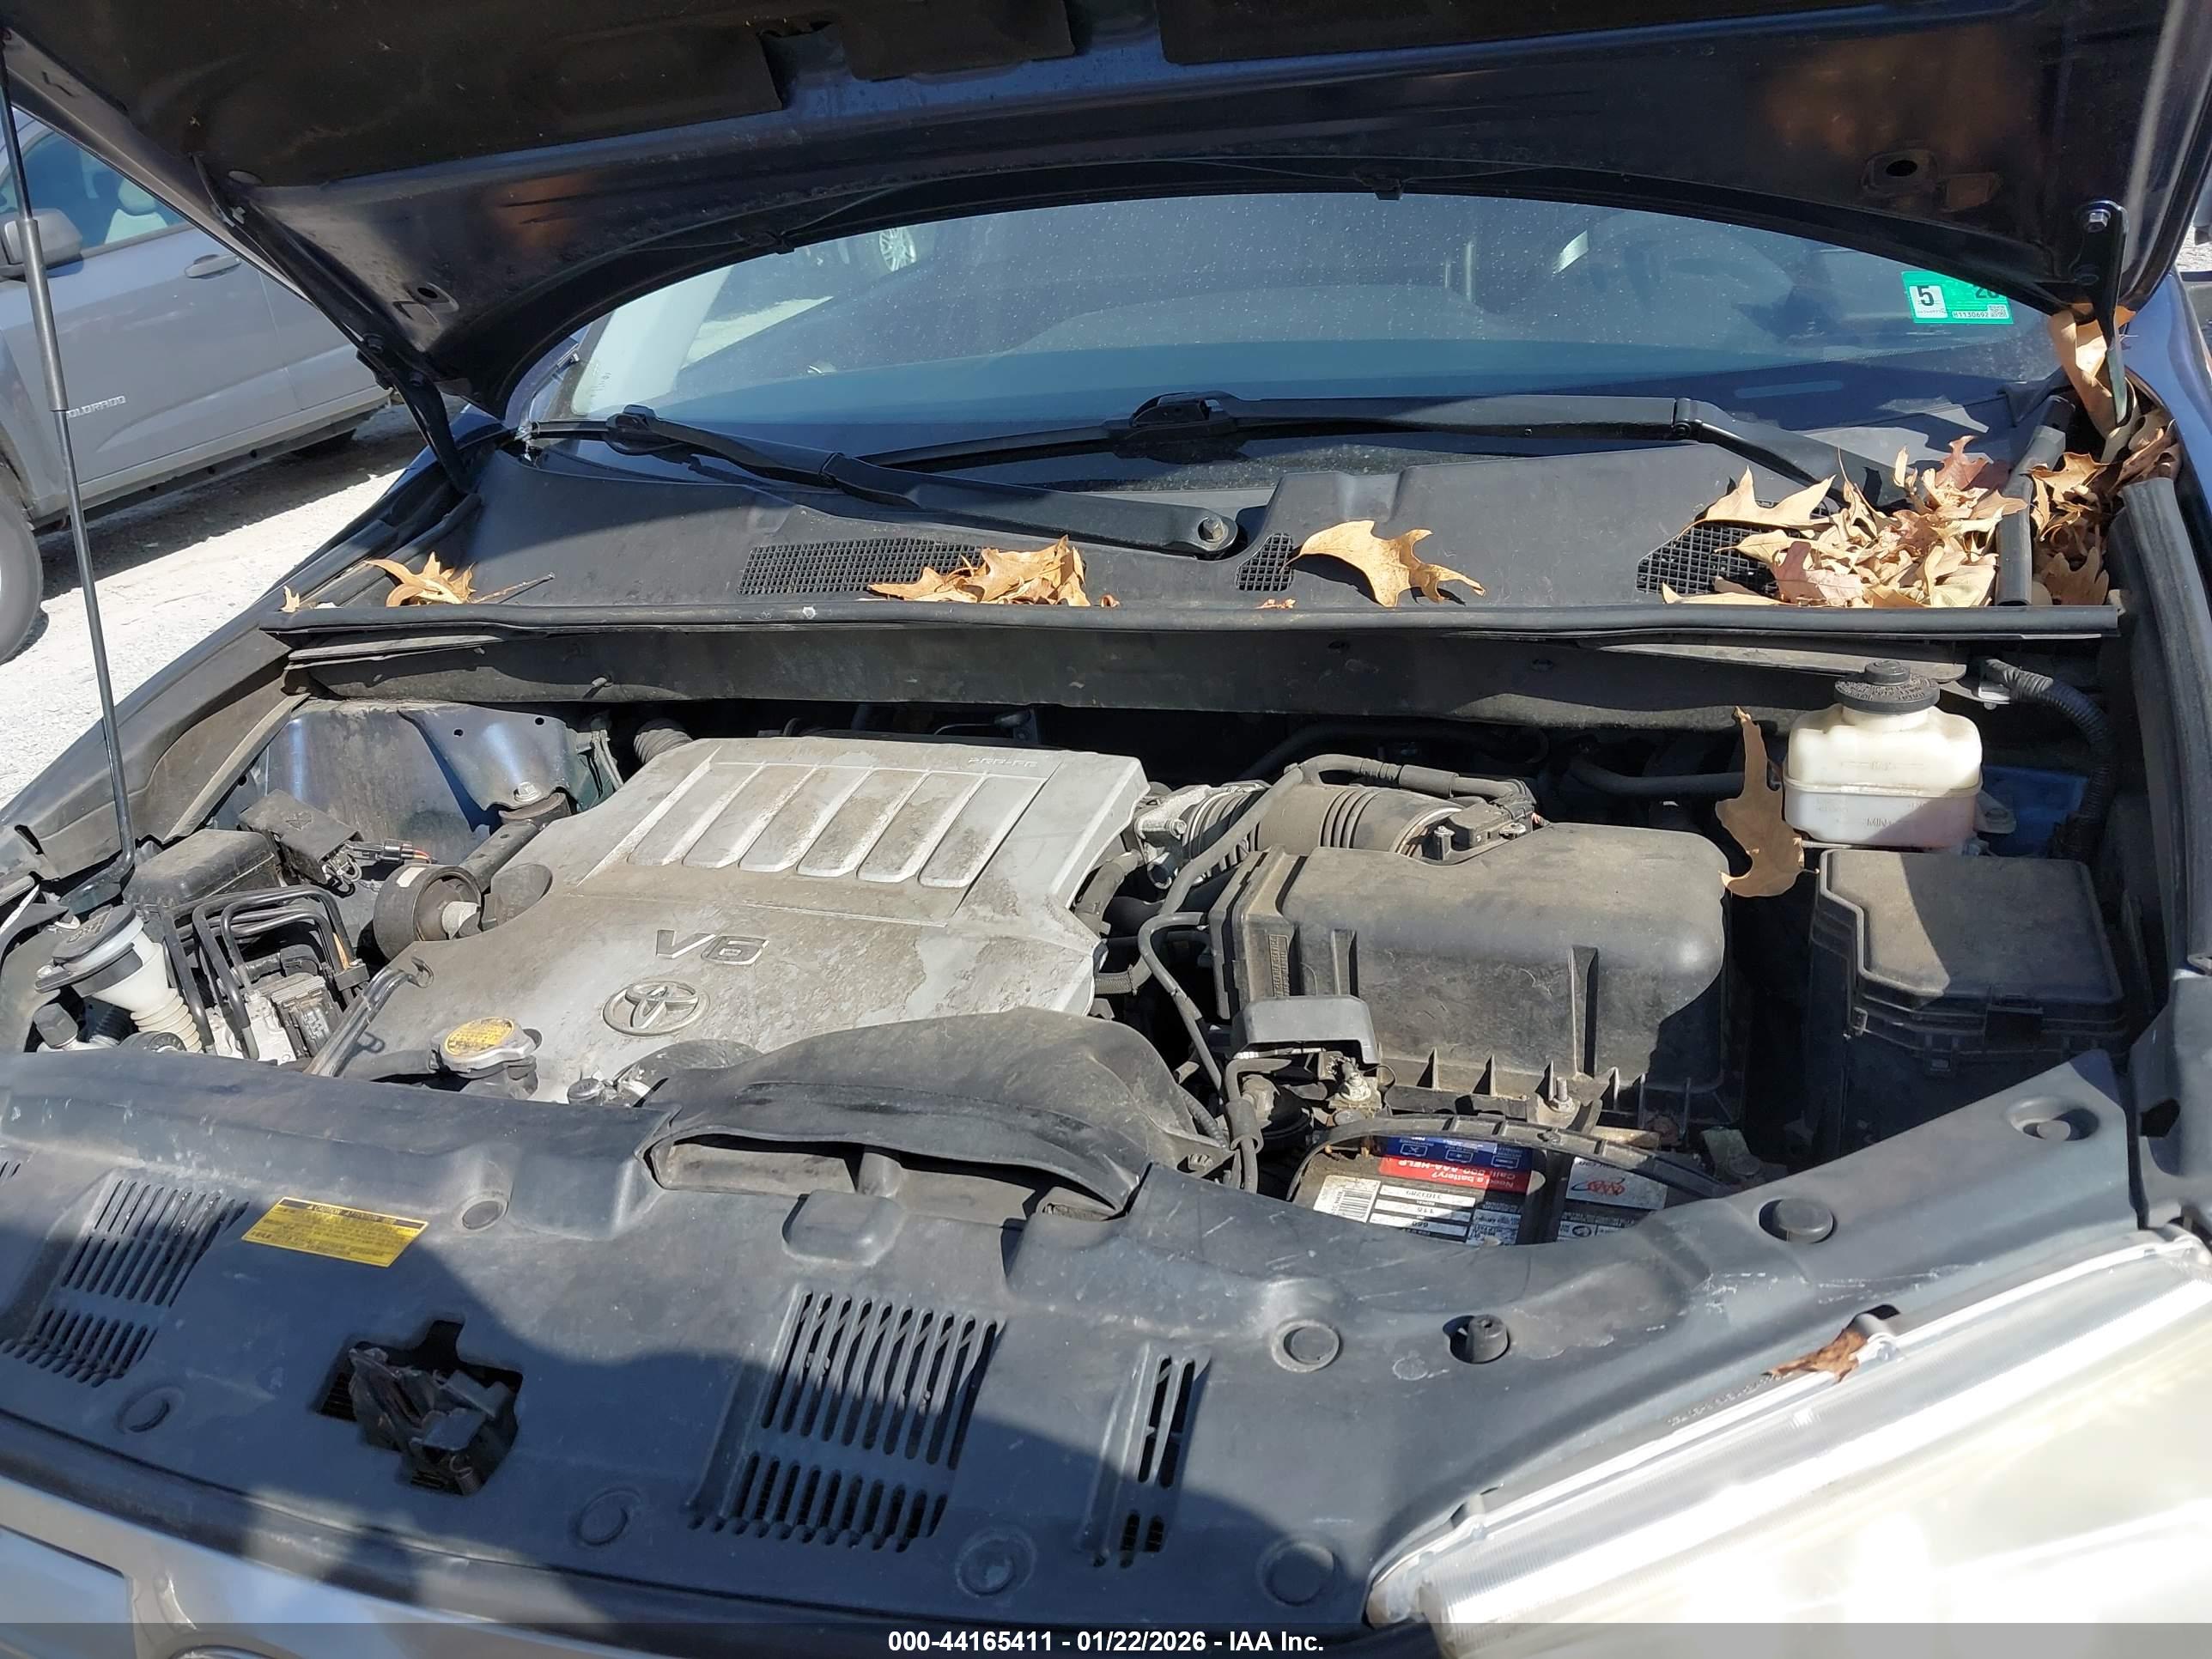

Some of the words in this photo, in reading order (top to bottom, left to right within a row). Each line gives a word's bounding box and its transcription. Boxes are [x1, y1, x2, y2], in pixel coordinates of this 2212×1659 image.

[1917, 286, 1935, 306] 5
[66, 395, 126, 419] OLORADO
[655, 929, 769, 966] V6
[1431, 1170, 1475, 1183] battery?
